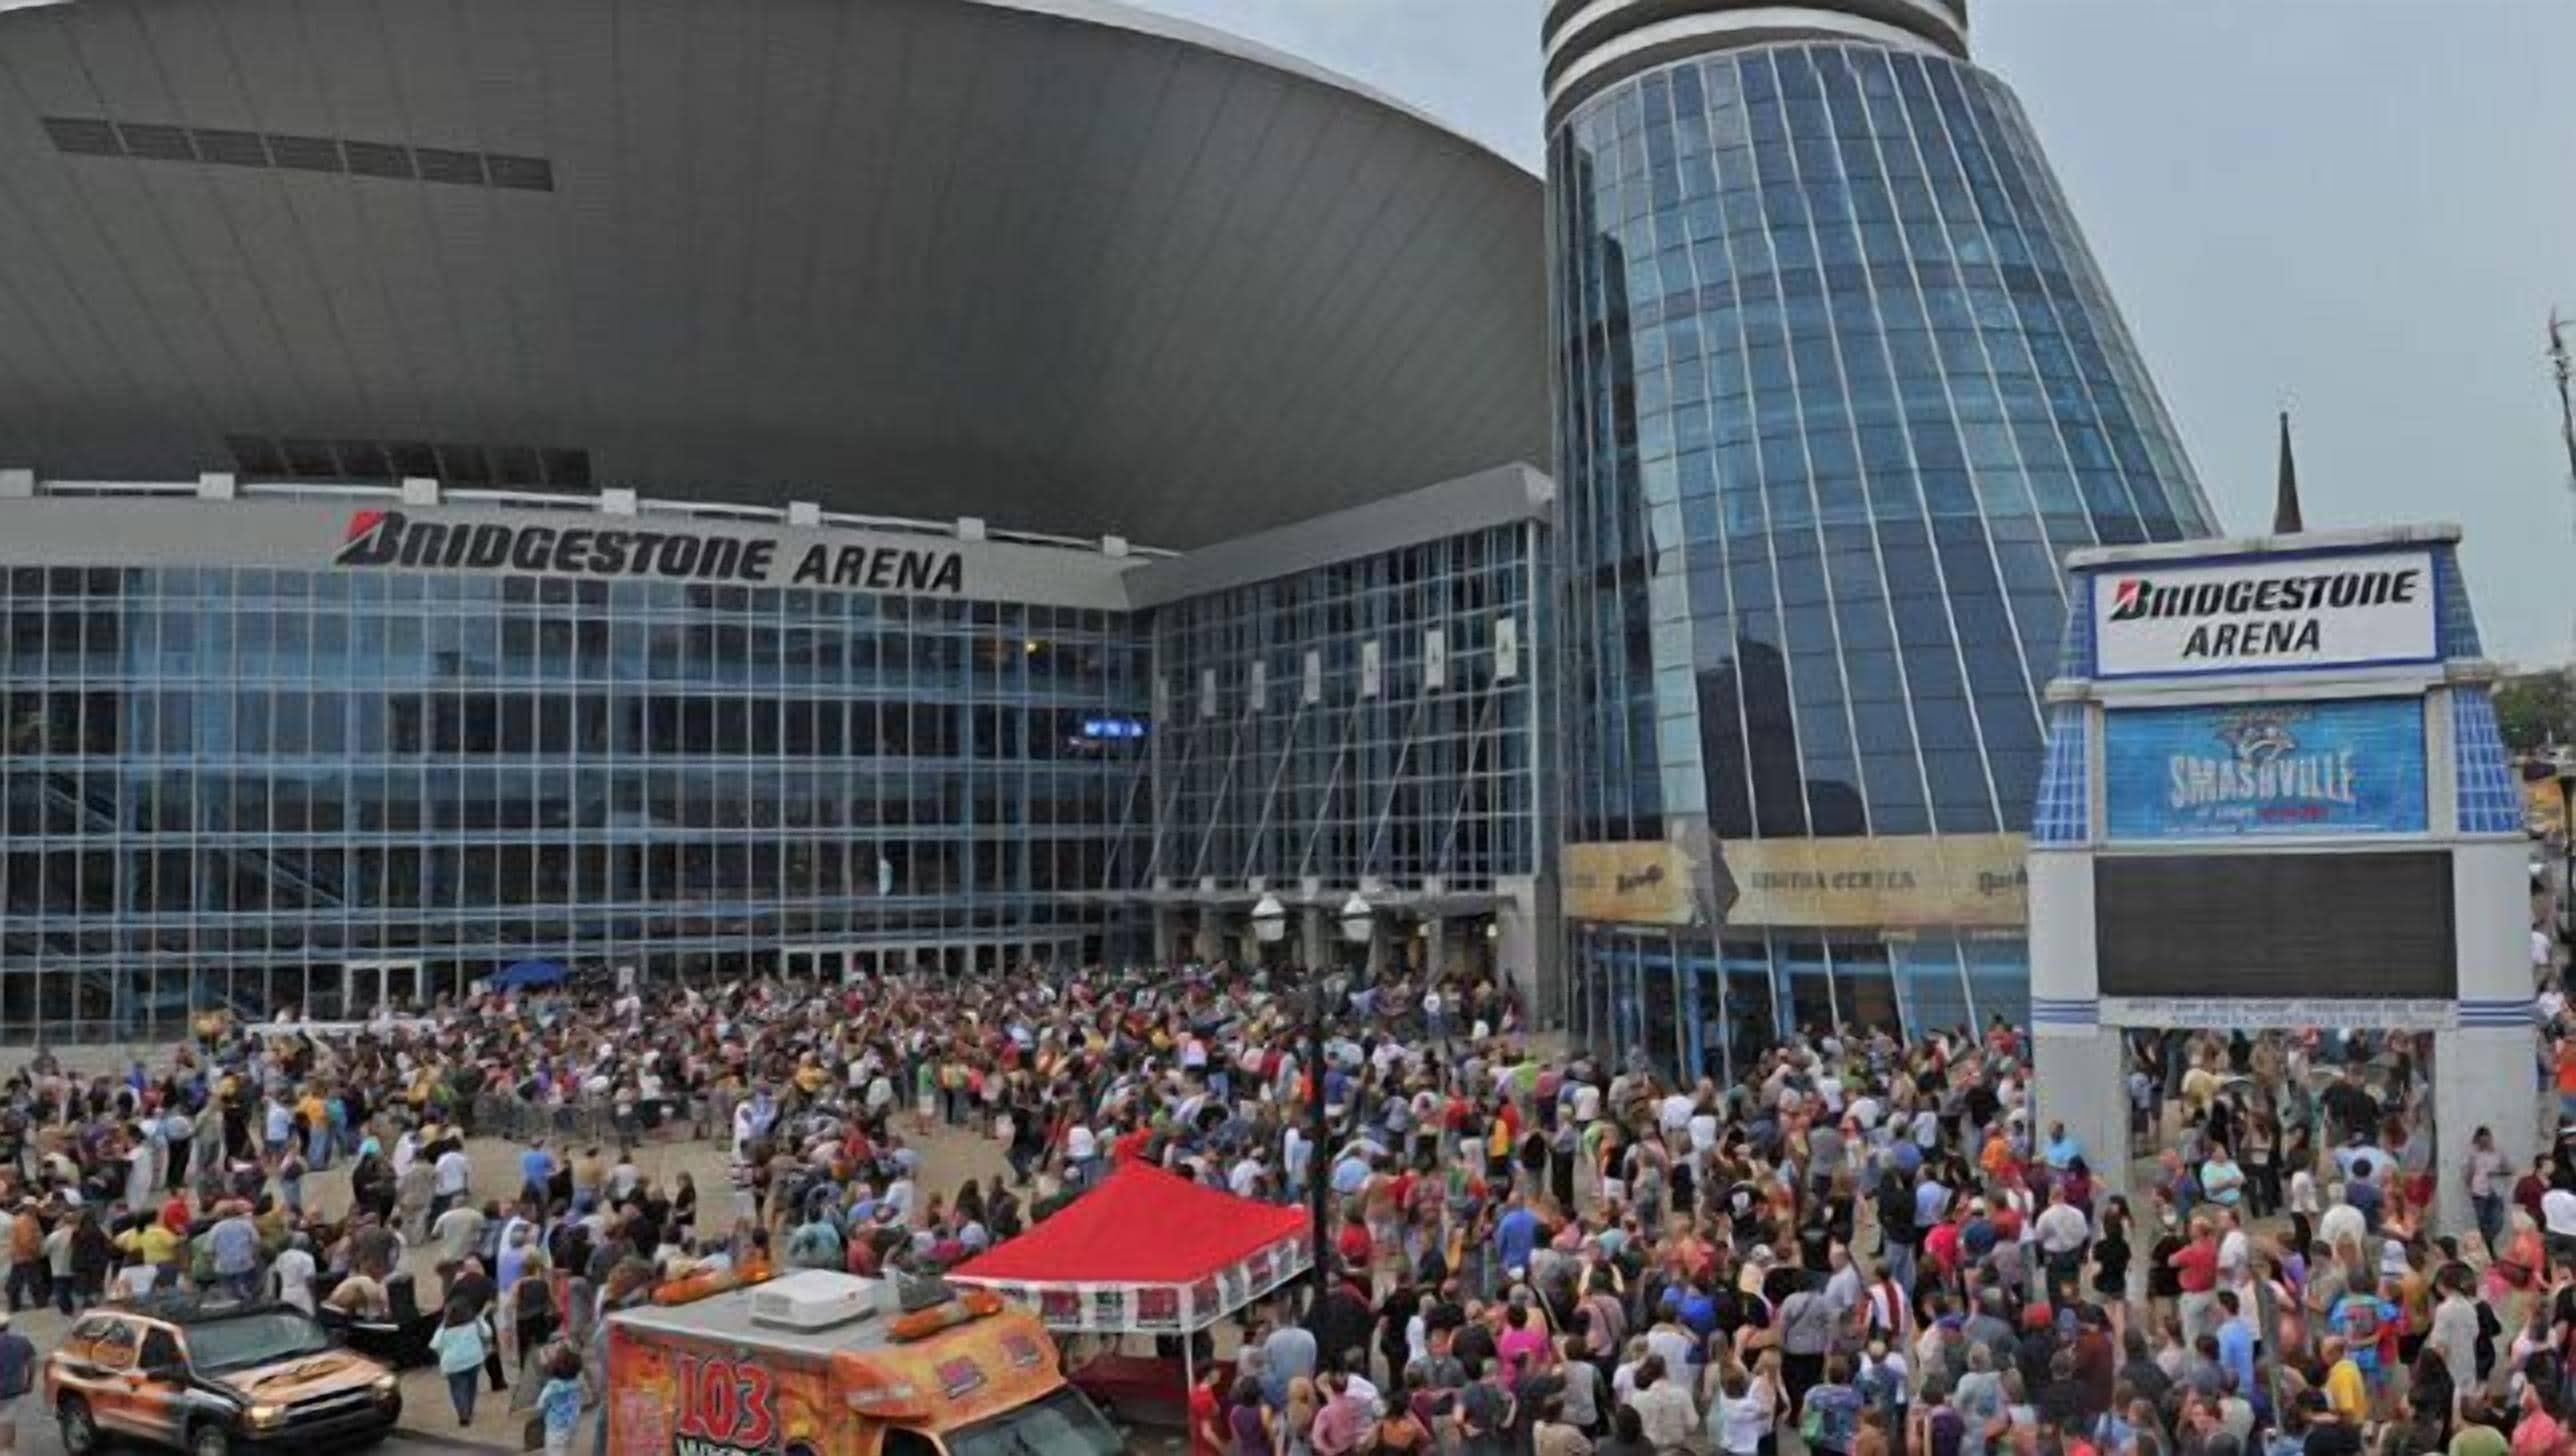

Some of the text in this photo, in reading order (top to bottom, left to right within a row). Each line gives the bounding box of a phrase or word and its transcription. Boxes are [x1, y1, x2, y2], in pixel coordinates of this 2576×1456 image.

[336, 510, 963, 593] BRIDGESTONE ARENA
[2110, 569, 2419, 621] BRIDGESTONE
[2183, 619, 2321, 658] ARENA
[2169, 750, 2357, 808] SMASHVILLE
[678, 1354, 773, 1448] 103
